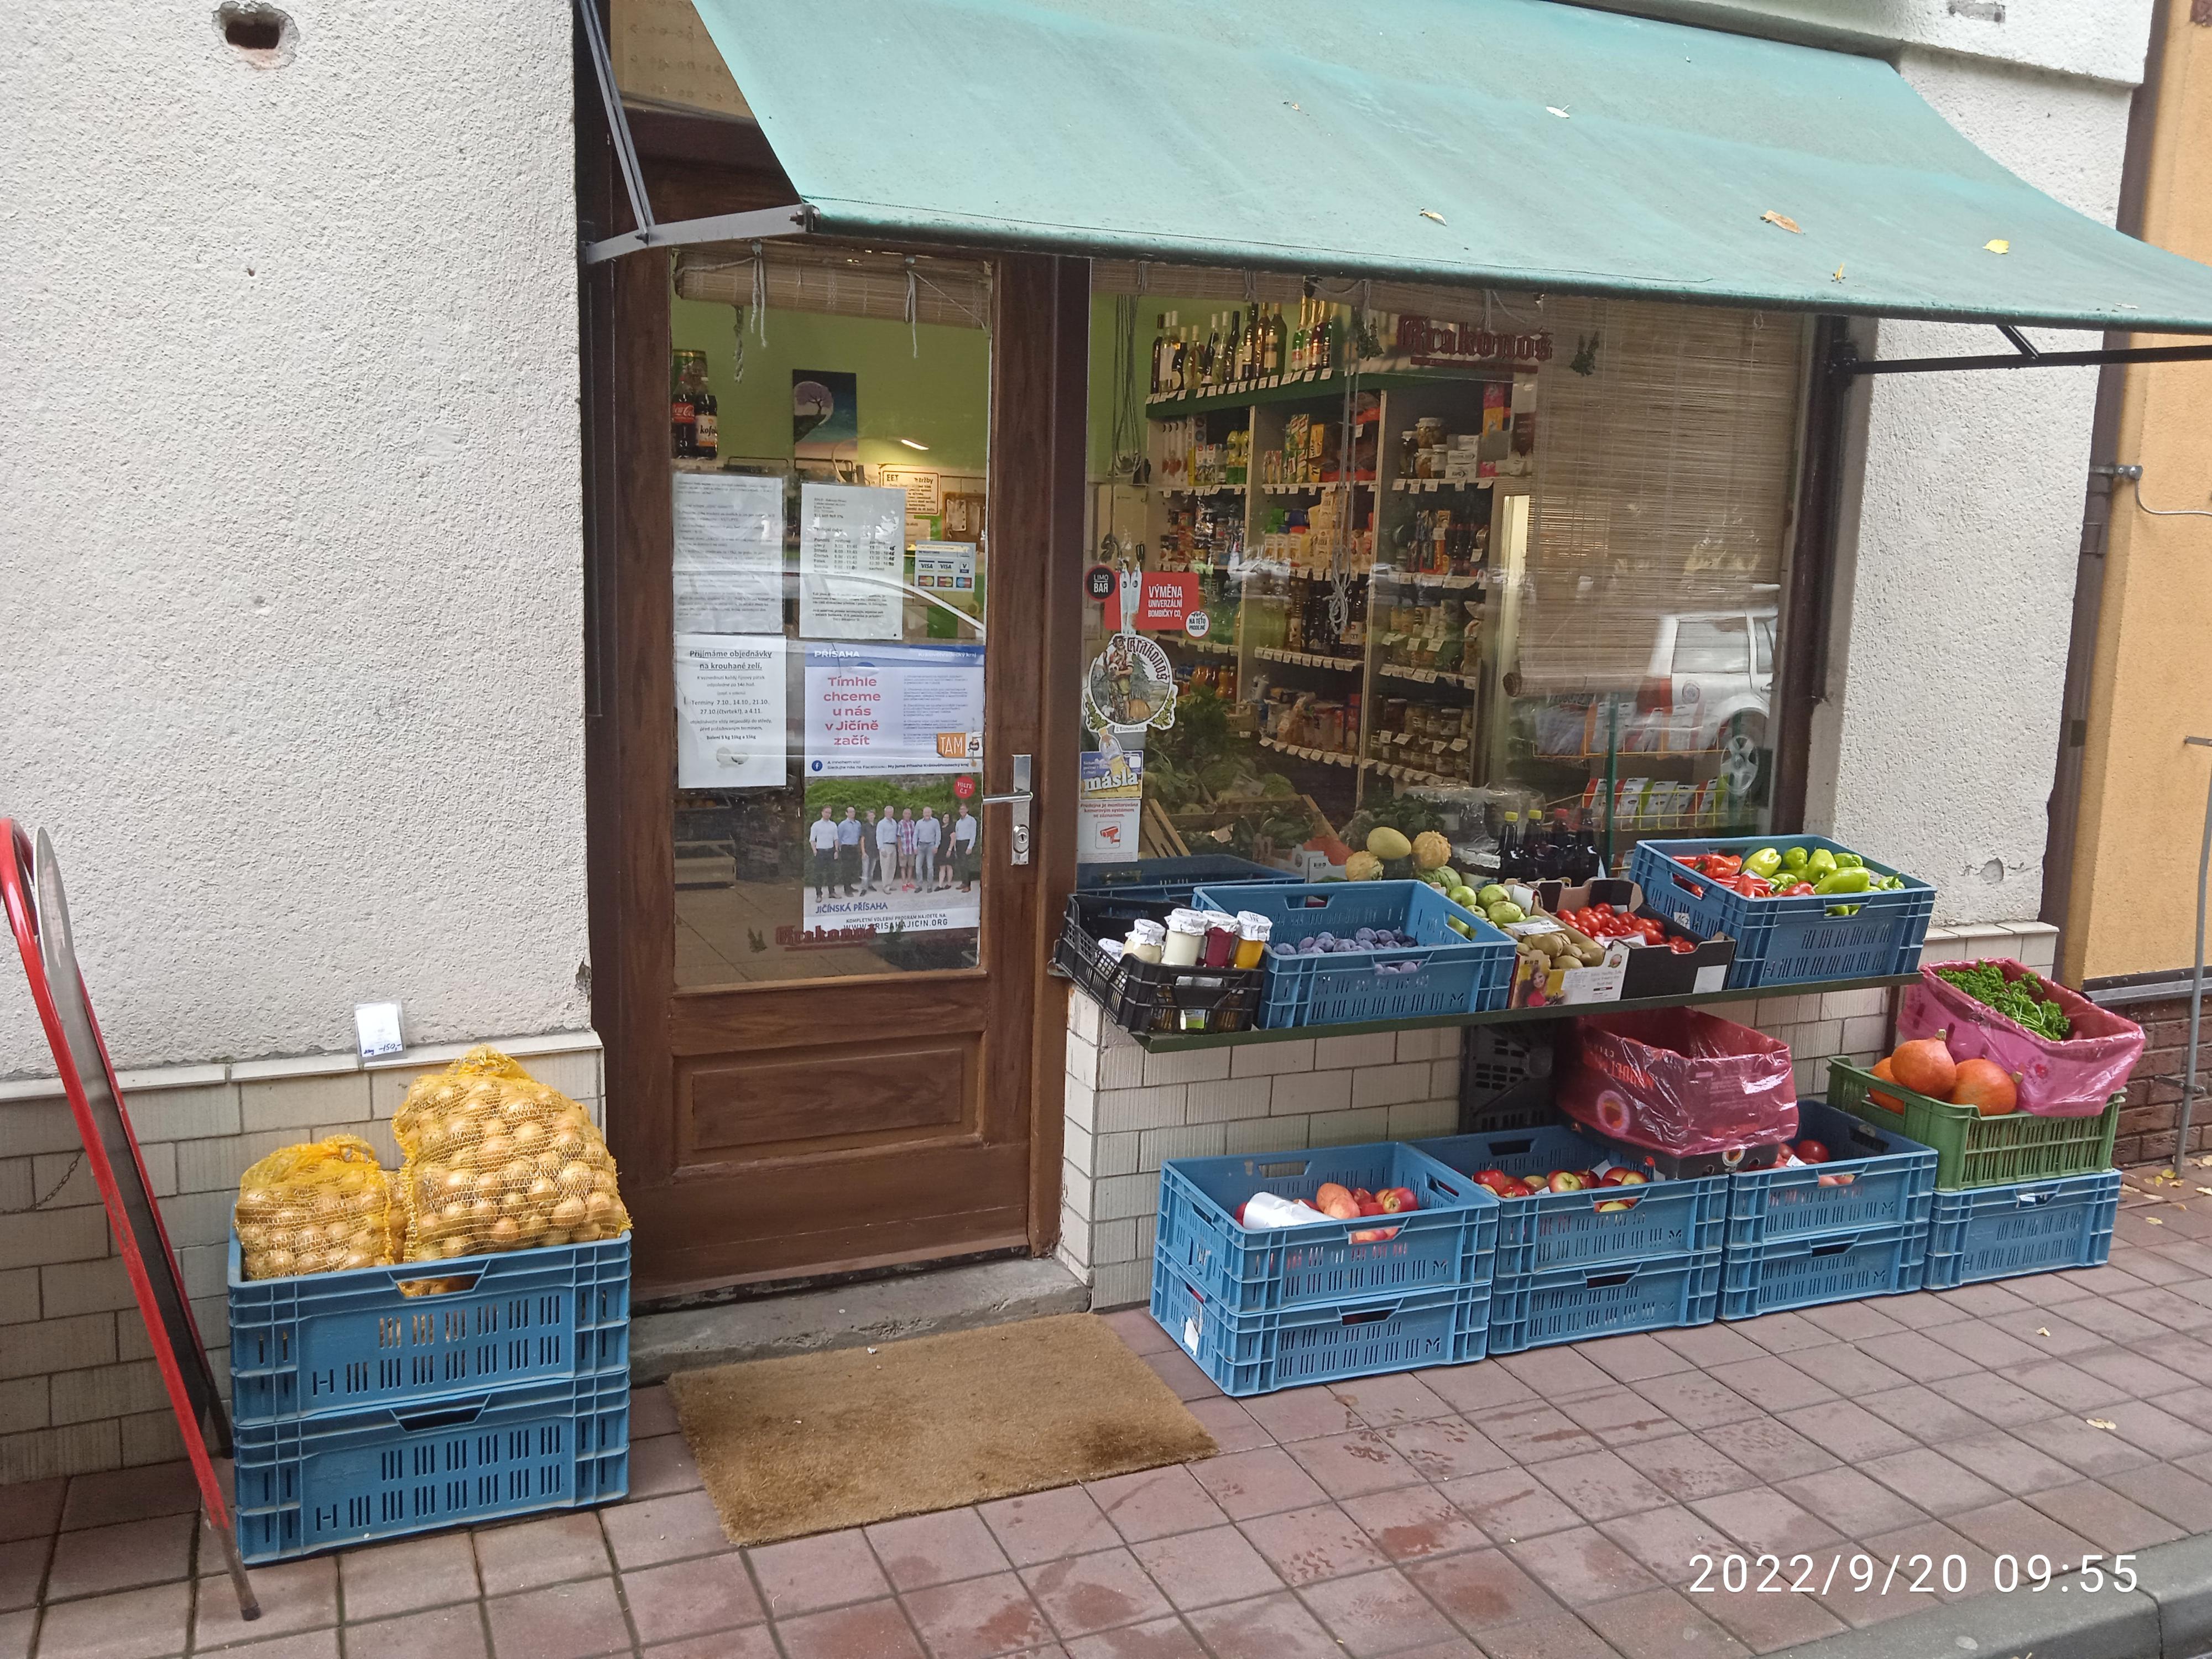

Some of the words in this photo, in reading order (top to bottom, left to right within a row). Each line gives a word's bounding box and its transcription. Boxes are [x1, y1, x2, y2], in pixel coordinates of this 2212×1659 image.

[1148, 584, 1183, 598] VÝMĚNA
[1148, 598, 1183, 608] UNIVERZÁLNÍ
[1147, 609, 1173, 618] BOMBIČKY
[690, 649, 728, 658] Přijímáme
[729, 649, 772, 659] objednávky
[814, 649, 860, 658] PŘÍSAHA
[828, 676, 877, 687] Tímhle
[823, 691, 881, 702] chceme
[833, 708, 842, 716] u
[845, 705, 872, 716] nás
[836, 720, 879, 731] Jičíně
[833, 734, 870, 745] začít
[941, 737, 963, 755] TAM
[1084, 769, 1138, 791] másla
[815, 902, 851, 914] JIČÍNSKÁ
[853, 901, 888, 911] PŘÍSAHA
